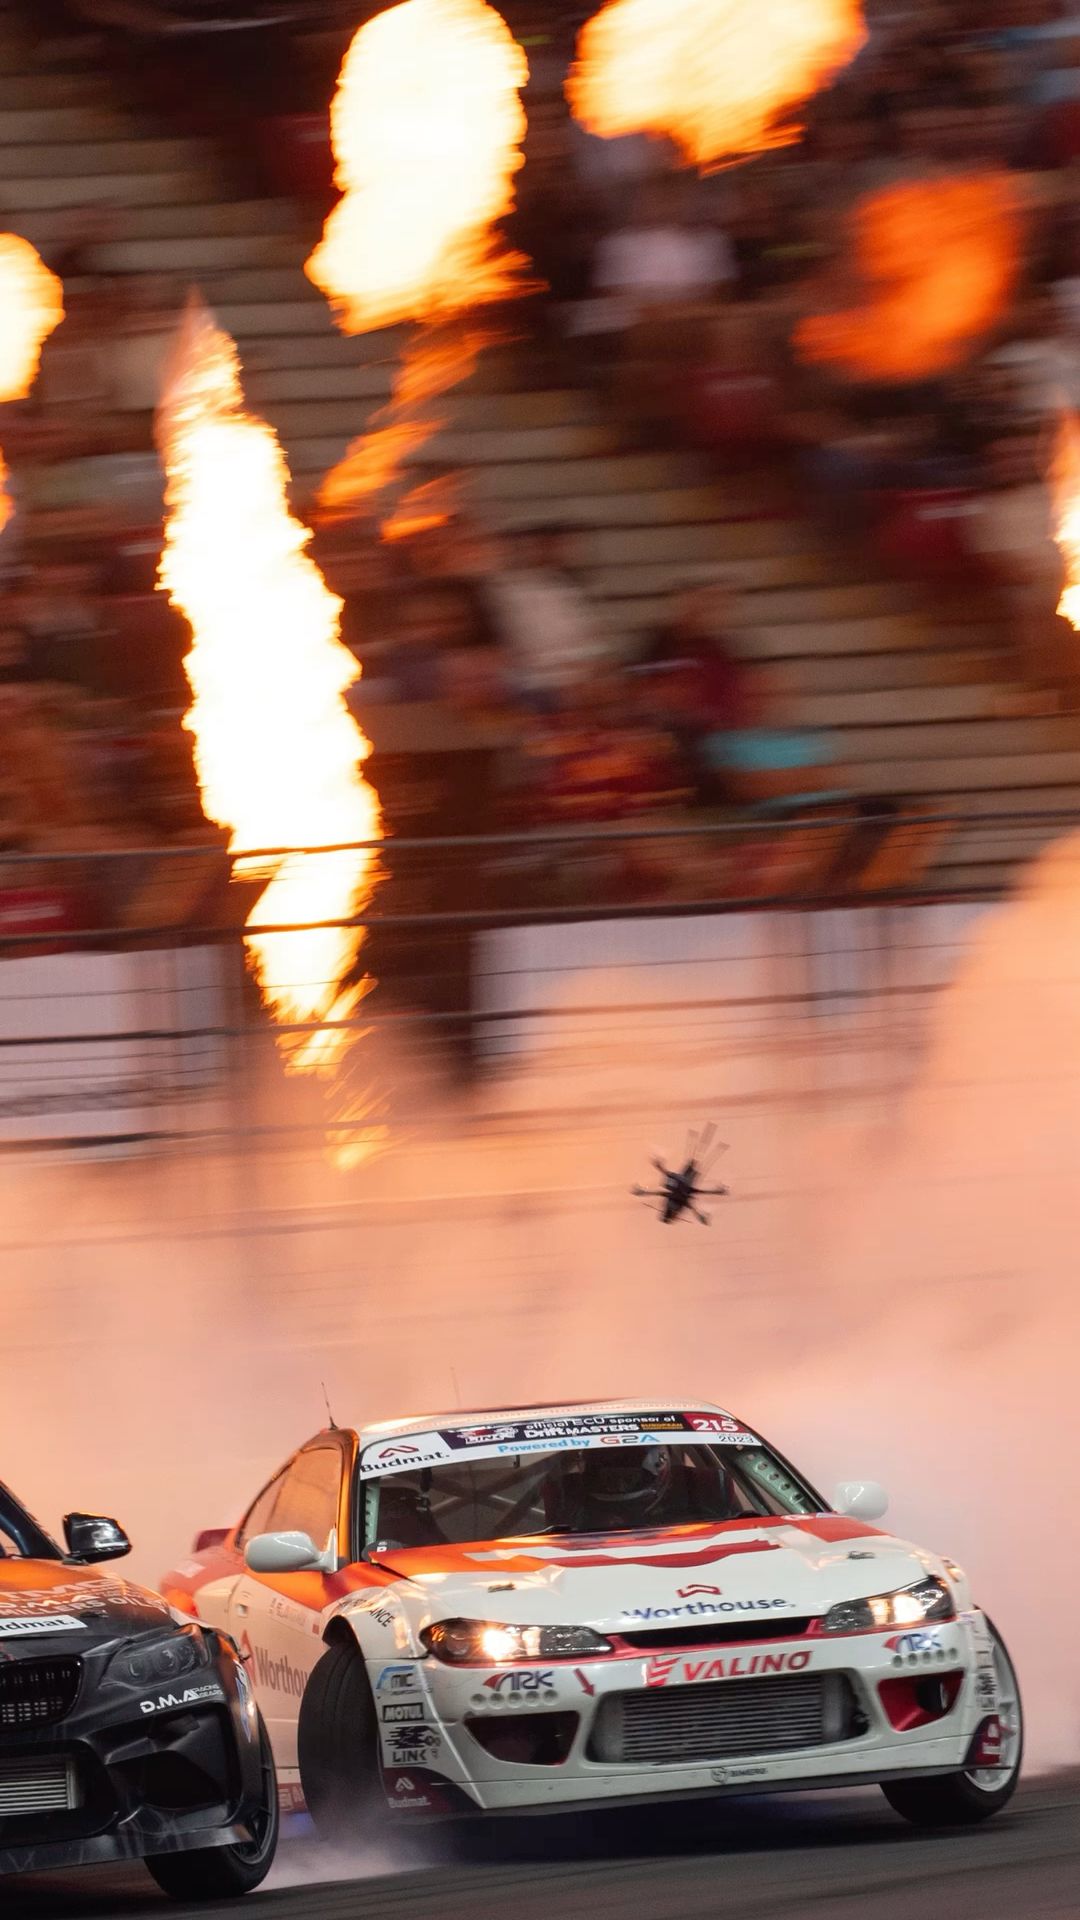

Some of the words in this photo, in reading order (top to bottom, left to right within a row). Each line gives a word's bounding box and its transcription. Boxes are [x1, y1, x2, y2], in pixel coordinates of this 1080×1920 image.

[572, 1417, 604, 1427] ECU
[609, 1417, 659, 1425] sponsor
[693, 1419, 738, 1432] 215
[497, 1439, 569, 1453] Powered
[571, 1438, 590, 1447] by
[600, 1434, 660, 1444] G2A
[719, 1435, 754, 1444] 2023
[360, 1451, 450, 1473] Budmat.
[683, 1650, 813, 1682] VALINO
[385, 1704, 423, 1721] MOTUL
